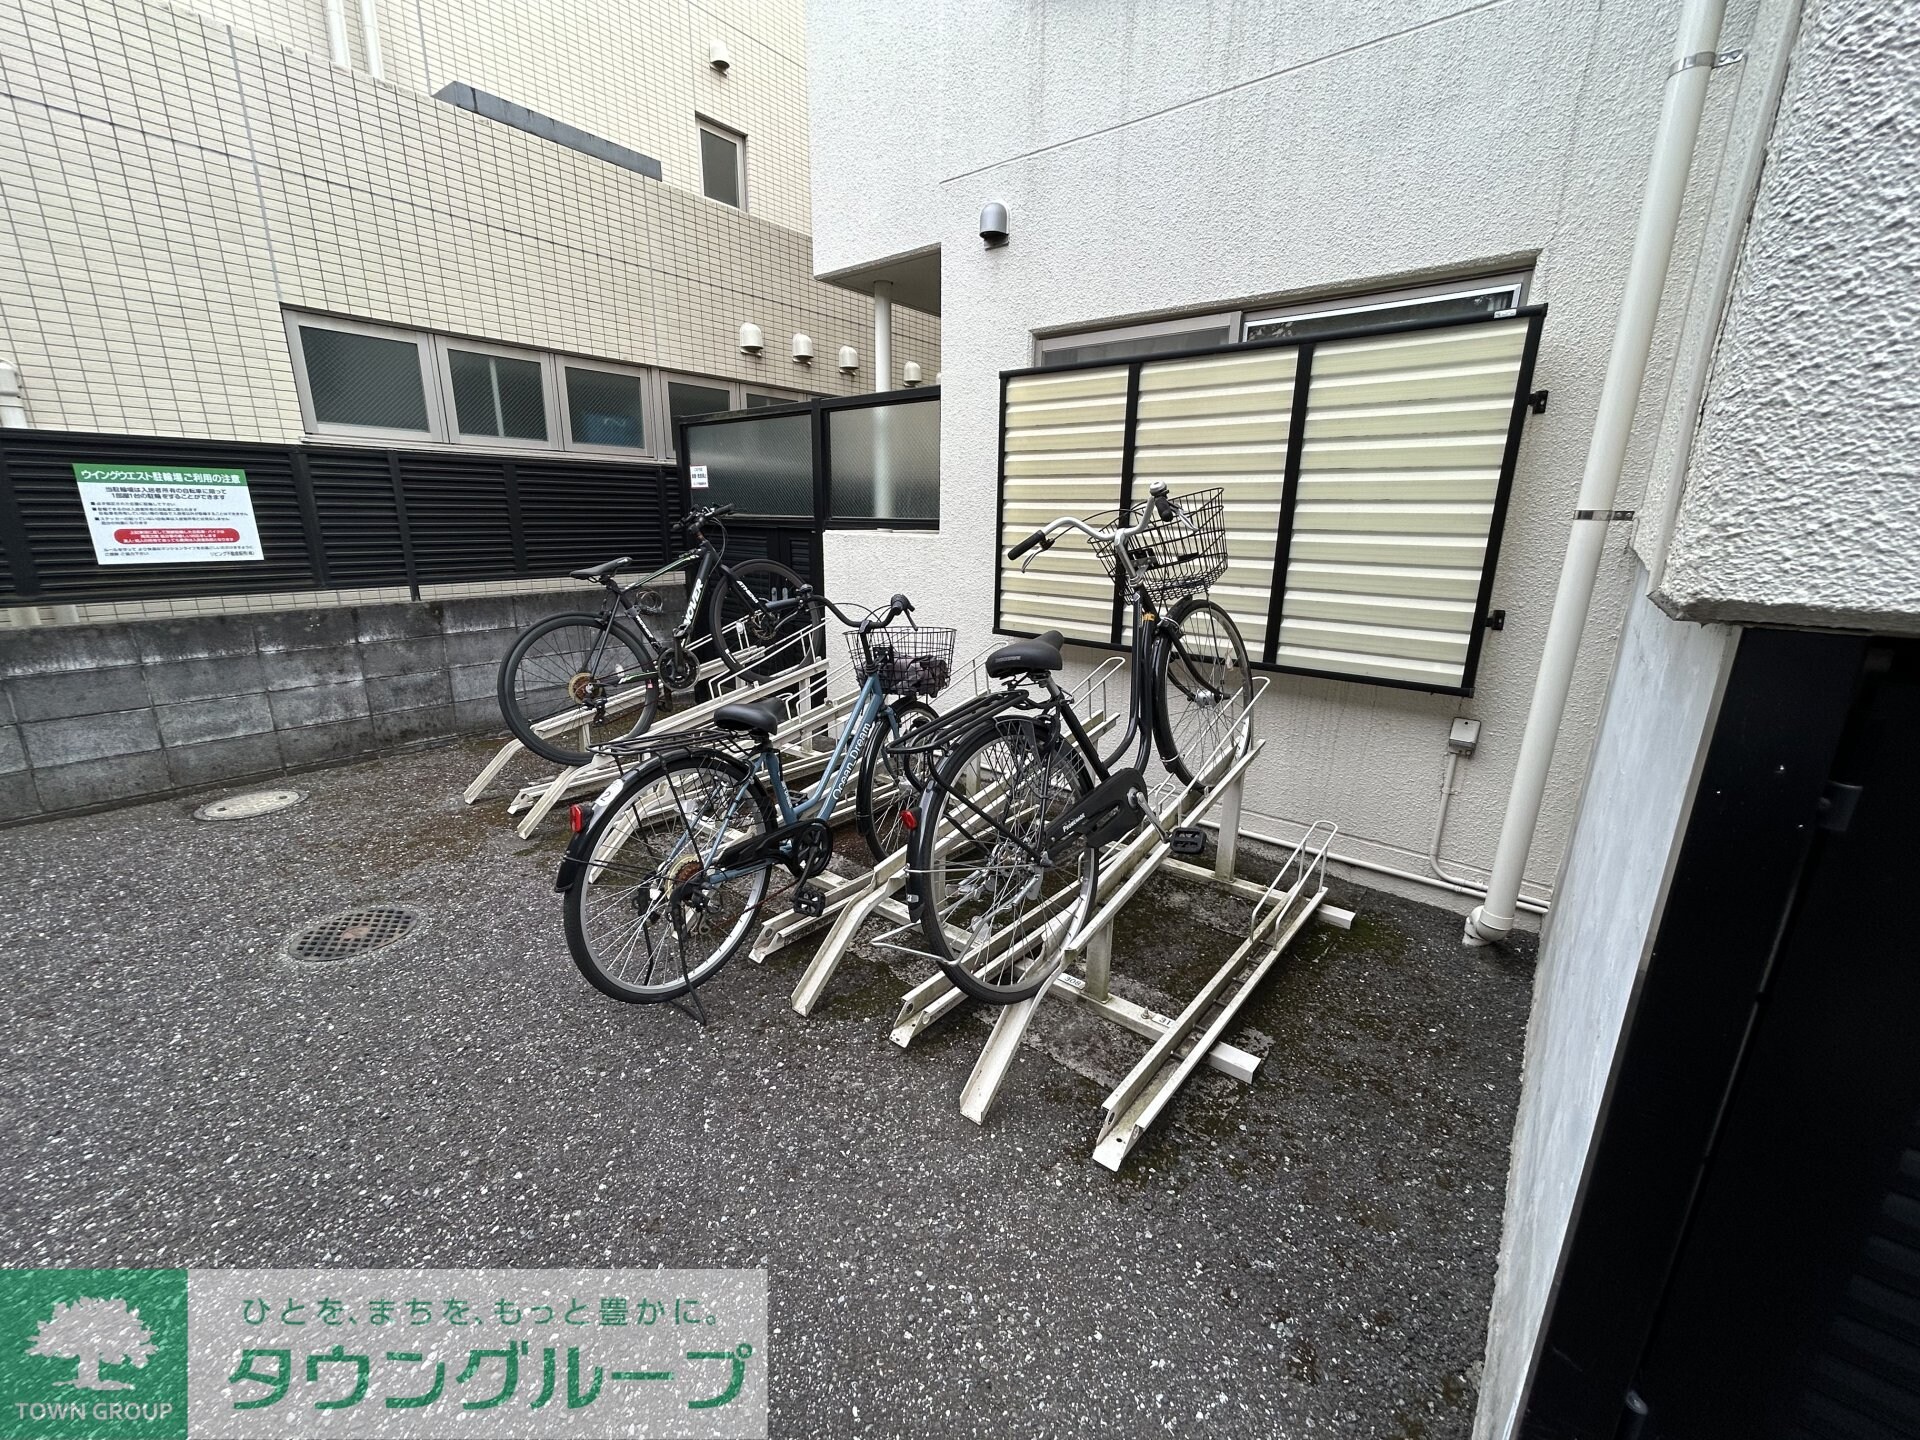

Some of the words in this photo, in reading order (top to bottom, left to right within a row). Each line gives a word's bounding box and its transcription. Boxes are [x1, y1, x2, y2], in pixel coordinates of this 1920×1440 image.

[832, 761, 855, 800] Ocean
[850, 722, 871, 760] Dream
[1064, 976, 1081, 986] 308
